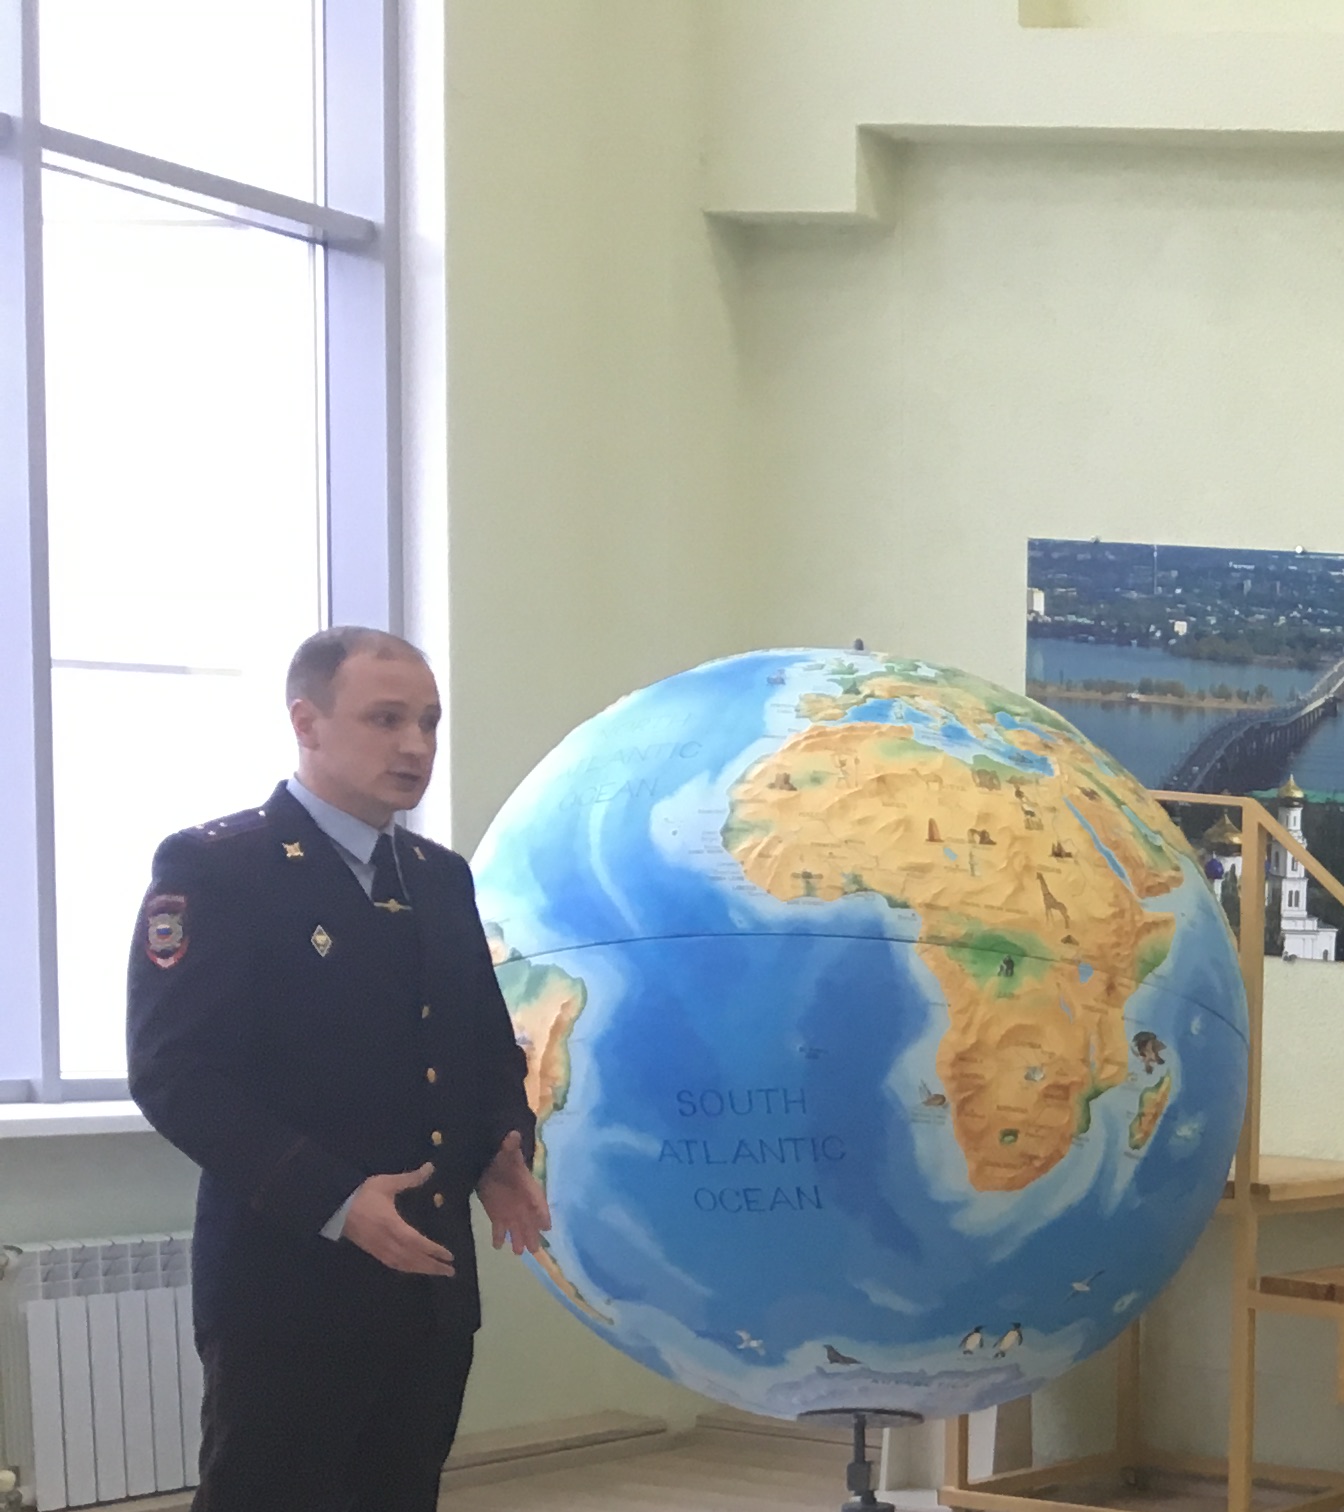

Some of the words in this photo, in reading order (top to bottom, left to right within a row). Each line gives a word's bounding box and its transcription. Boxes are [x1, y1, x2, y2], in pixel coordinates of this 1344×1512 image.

[677, 1086, 808, 1118] SOUTH
[657, 1136, 848, 1167] ATLANTIC
[693, 1184, 824, 1213] OCEAN
